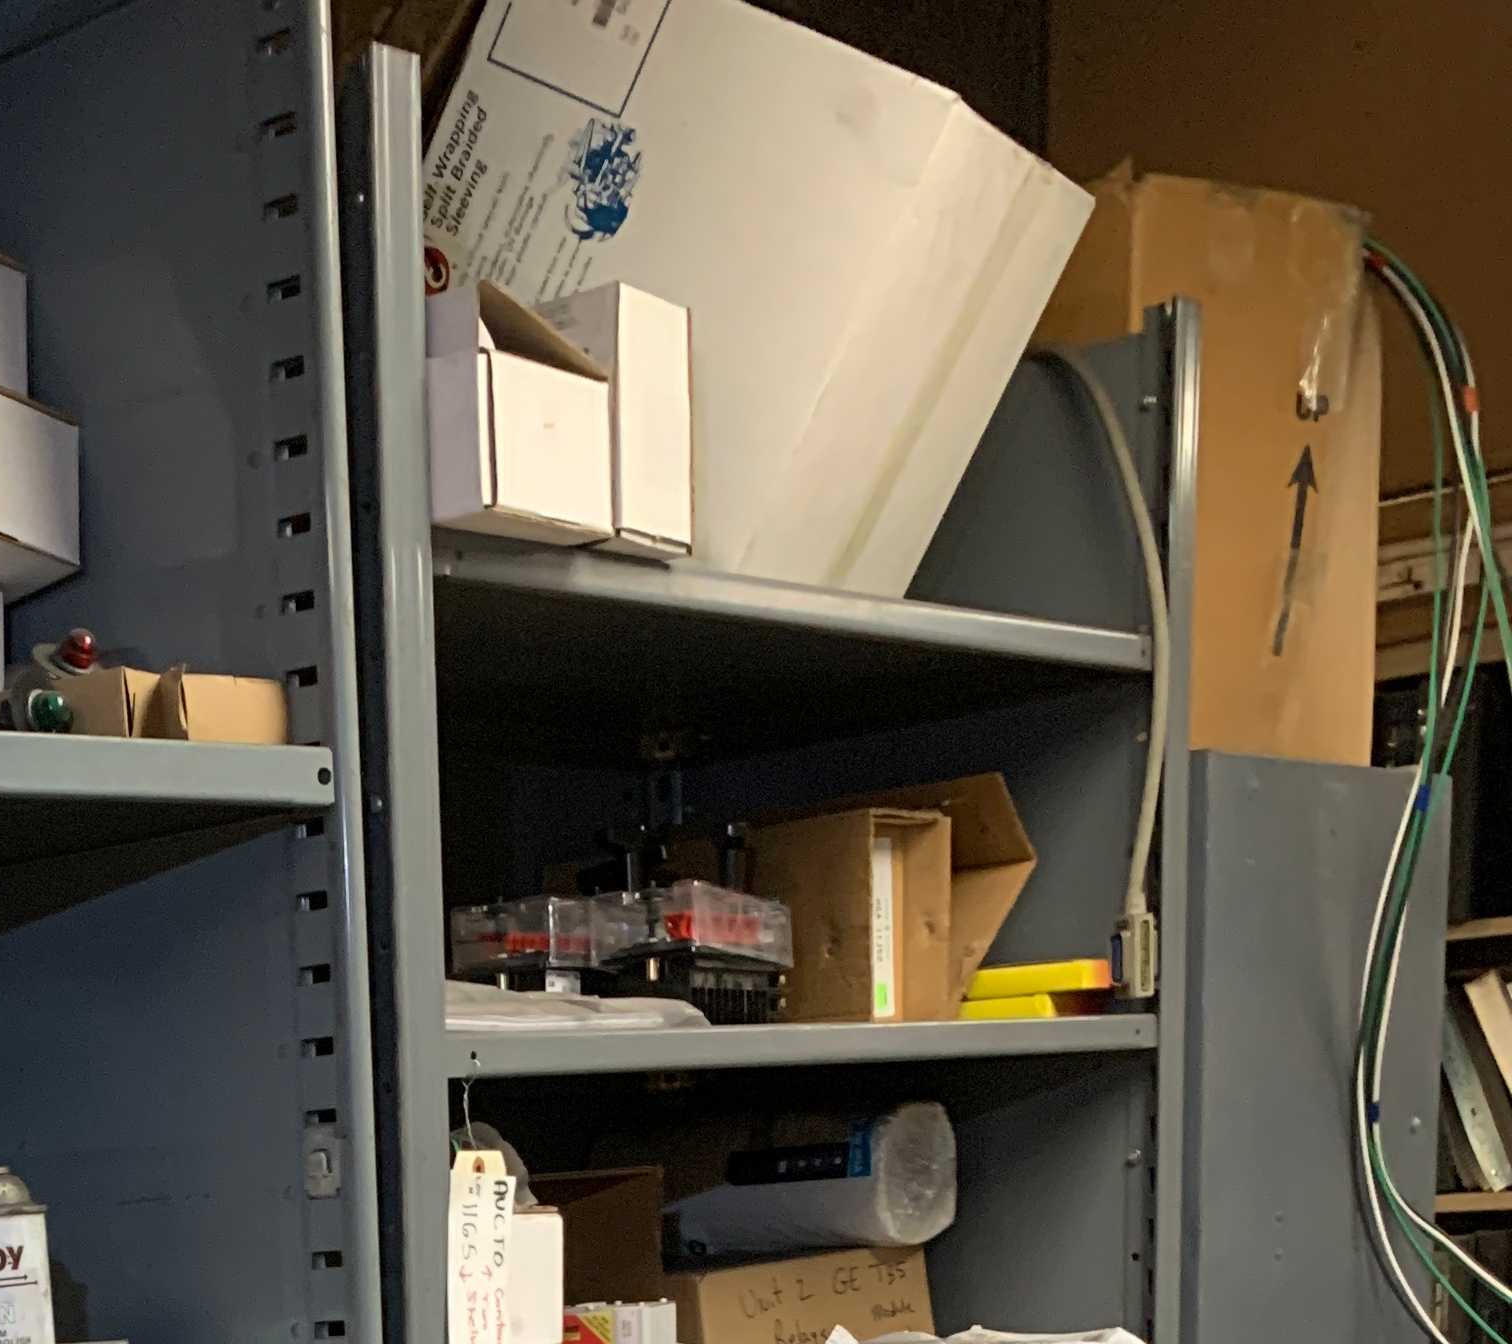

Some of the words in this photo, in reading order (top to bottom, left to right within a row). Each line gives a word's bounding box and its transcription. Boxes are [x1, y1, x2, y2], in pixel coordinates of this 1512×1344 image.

[431, 185, 456, 228] Split
[451, 106, 487, 181] Braided
[433, 90, 479, 180] Wrapping
[446, 159, 488, 236] Sleeving
